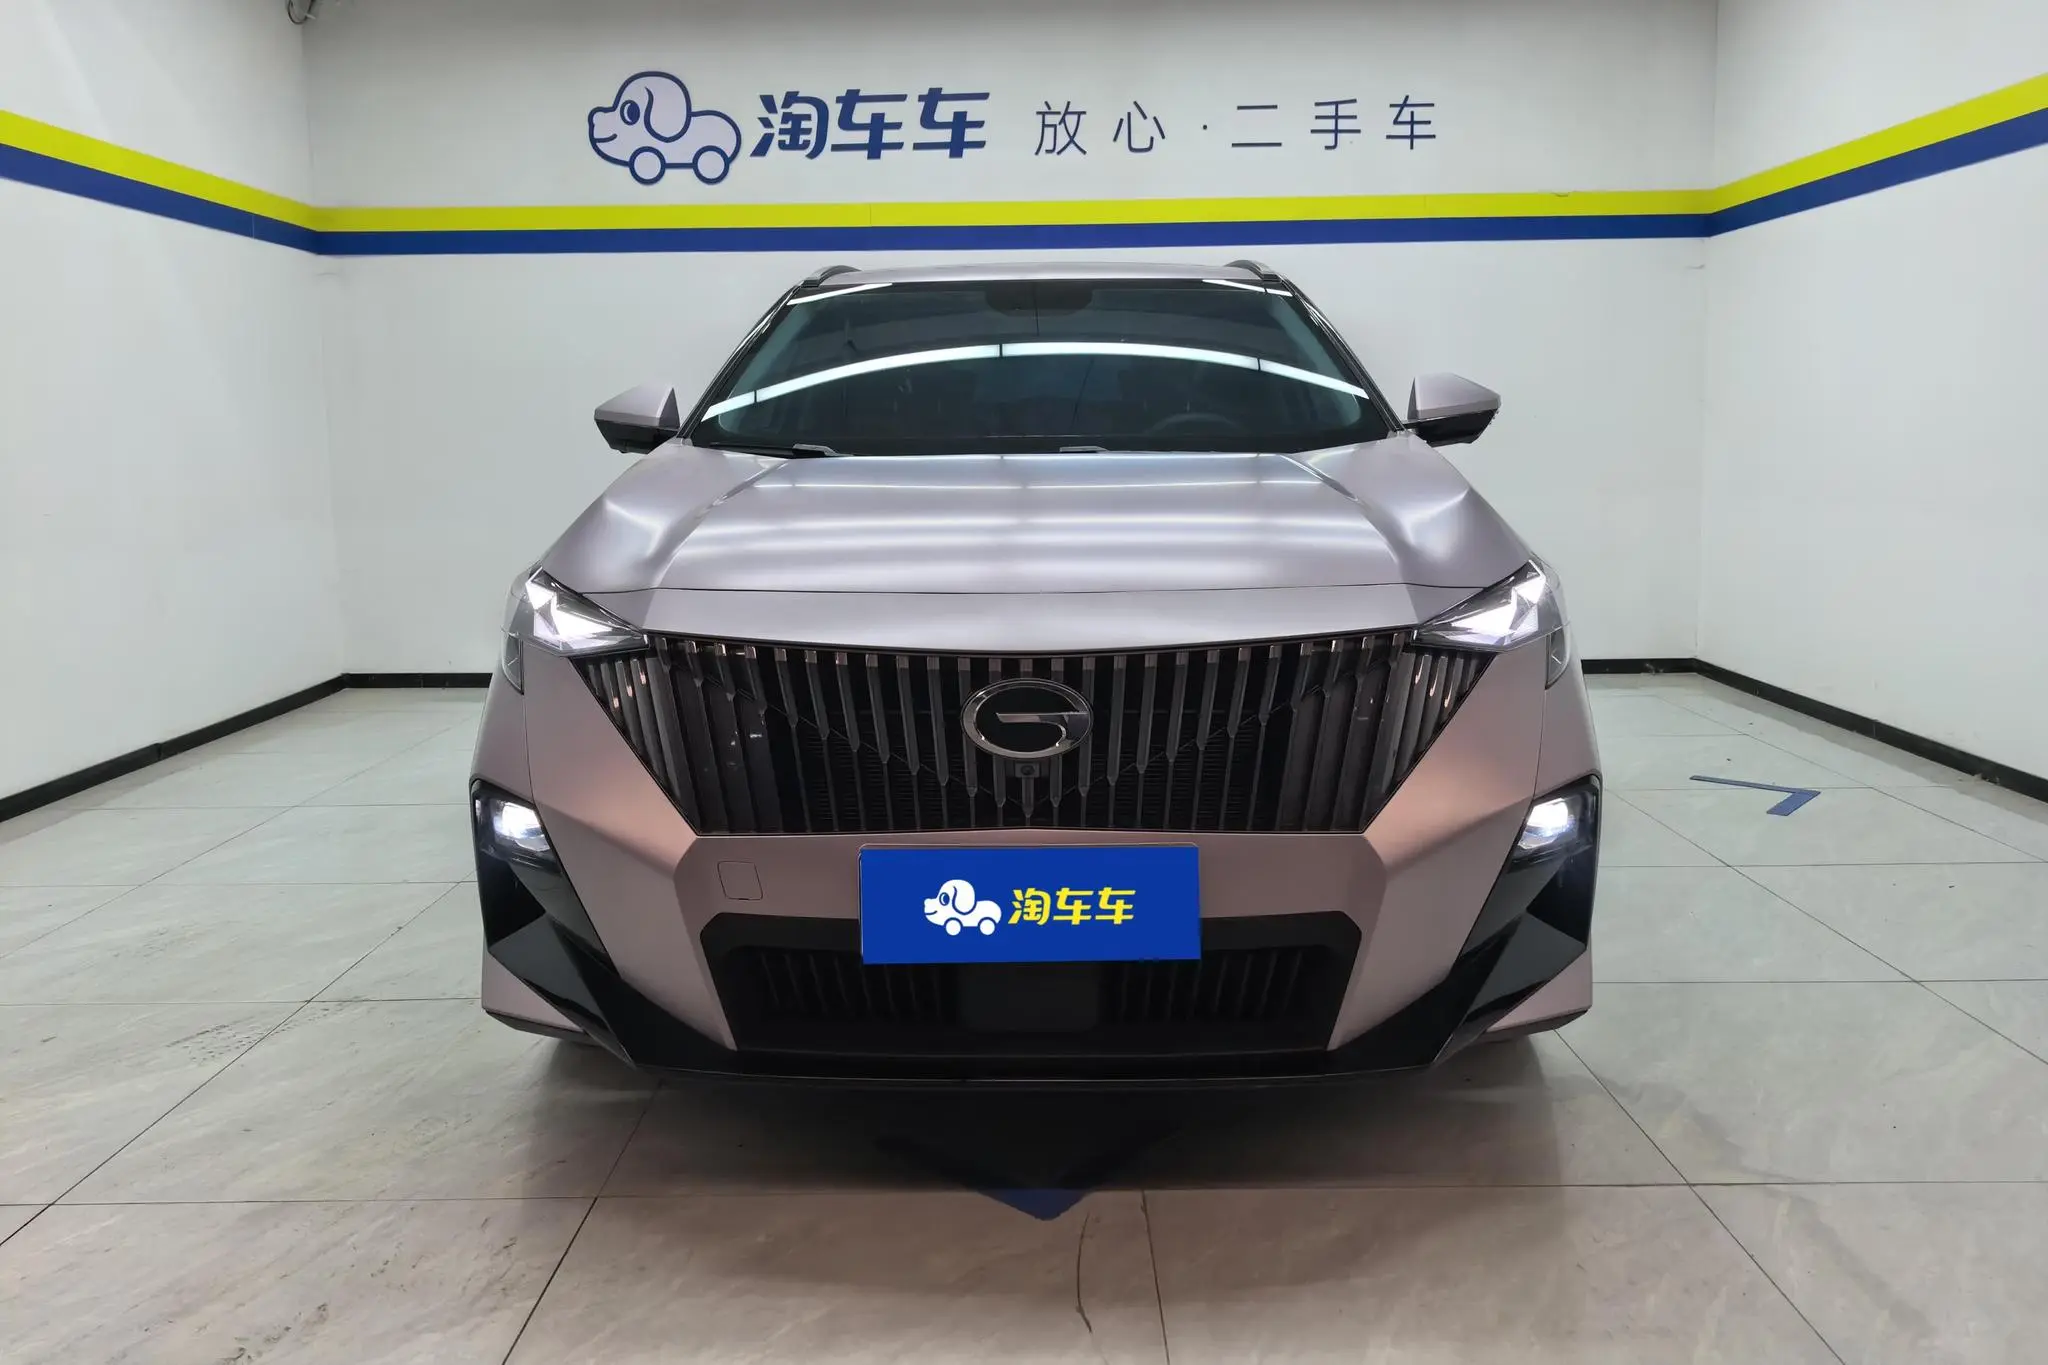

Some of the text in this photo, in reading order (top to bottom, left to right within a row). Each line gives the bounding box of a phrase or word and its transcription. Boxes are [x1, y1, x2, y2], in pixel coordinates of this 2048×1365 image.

[749, 87, 990, 160] 淘车车
[1007, 886, 1137, 926] 淘车车
